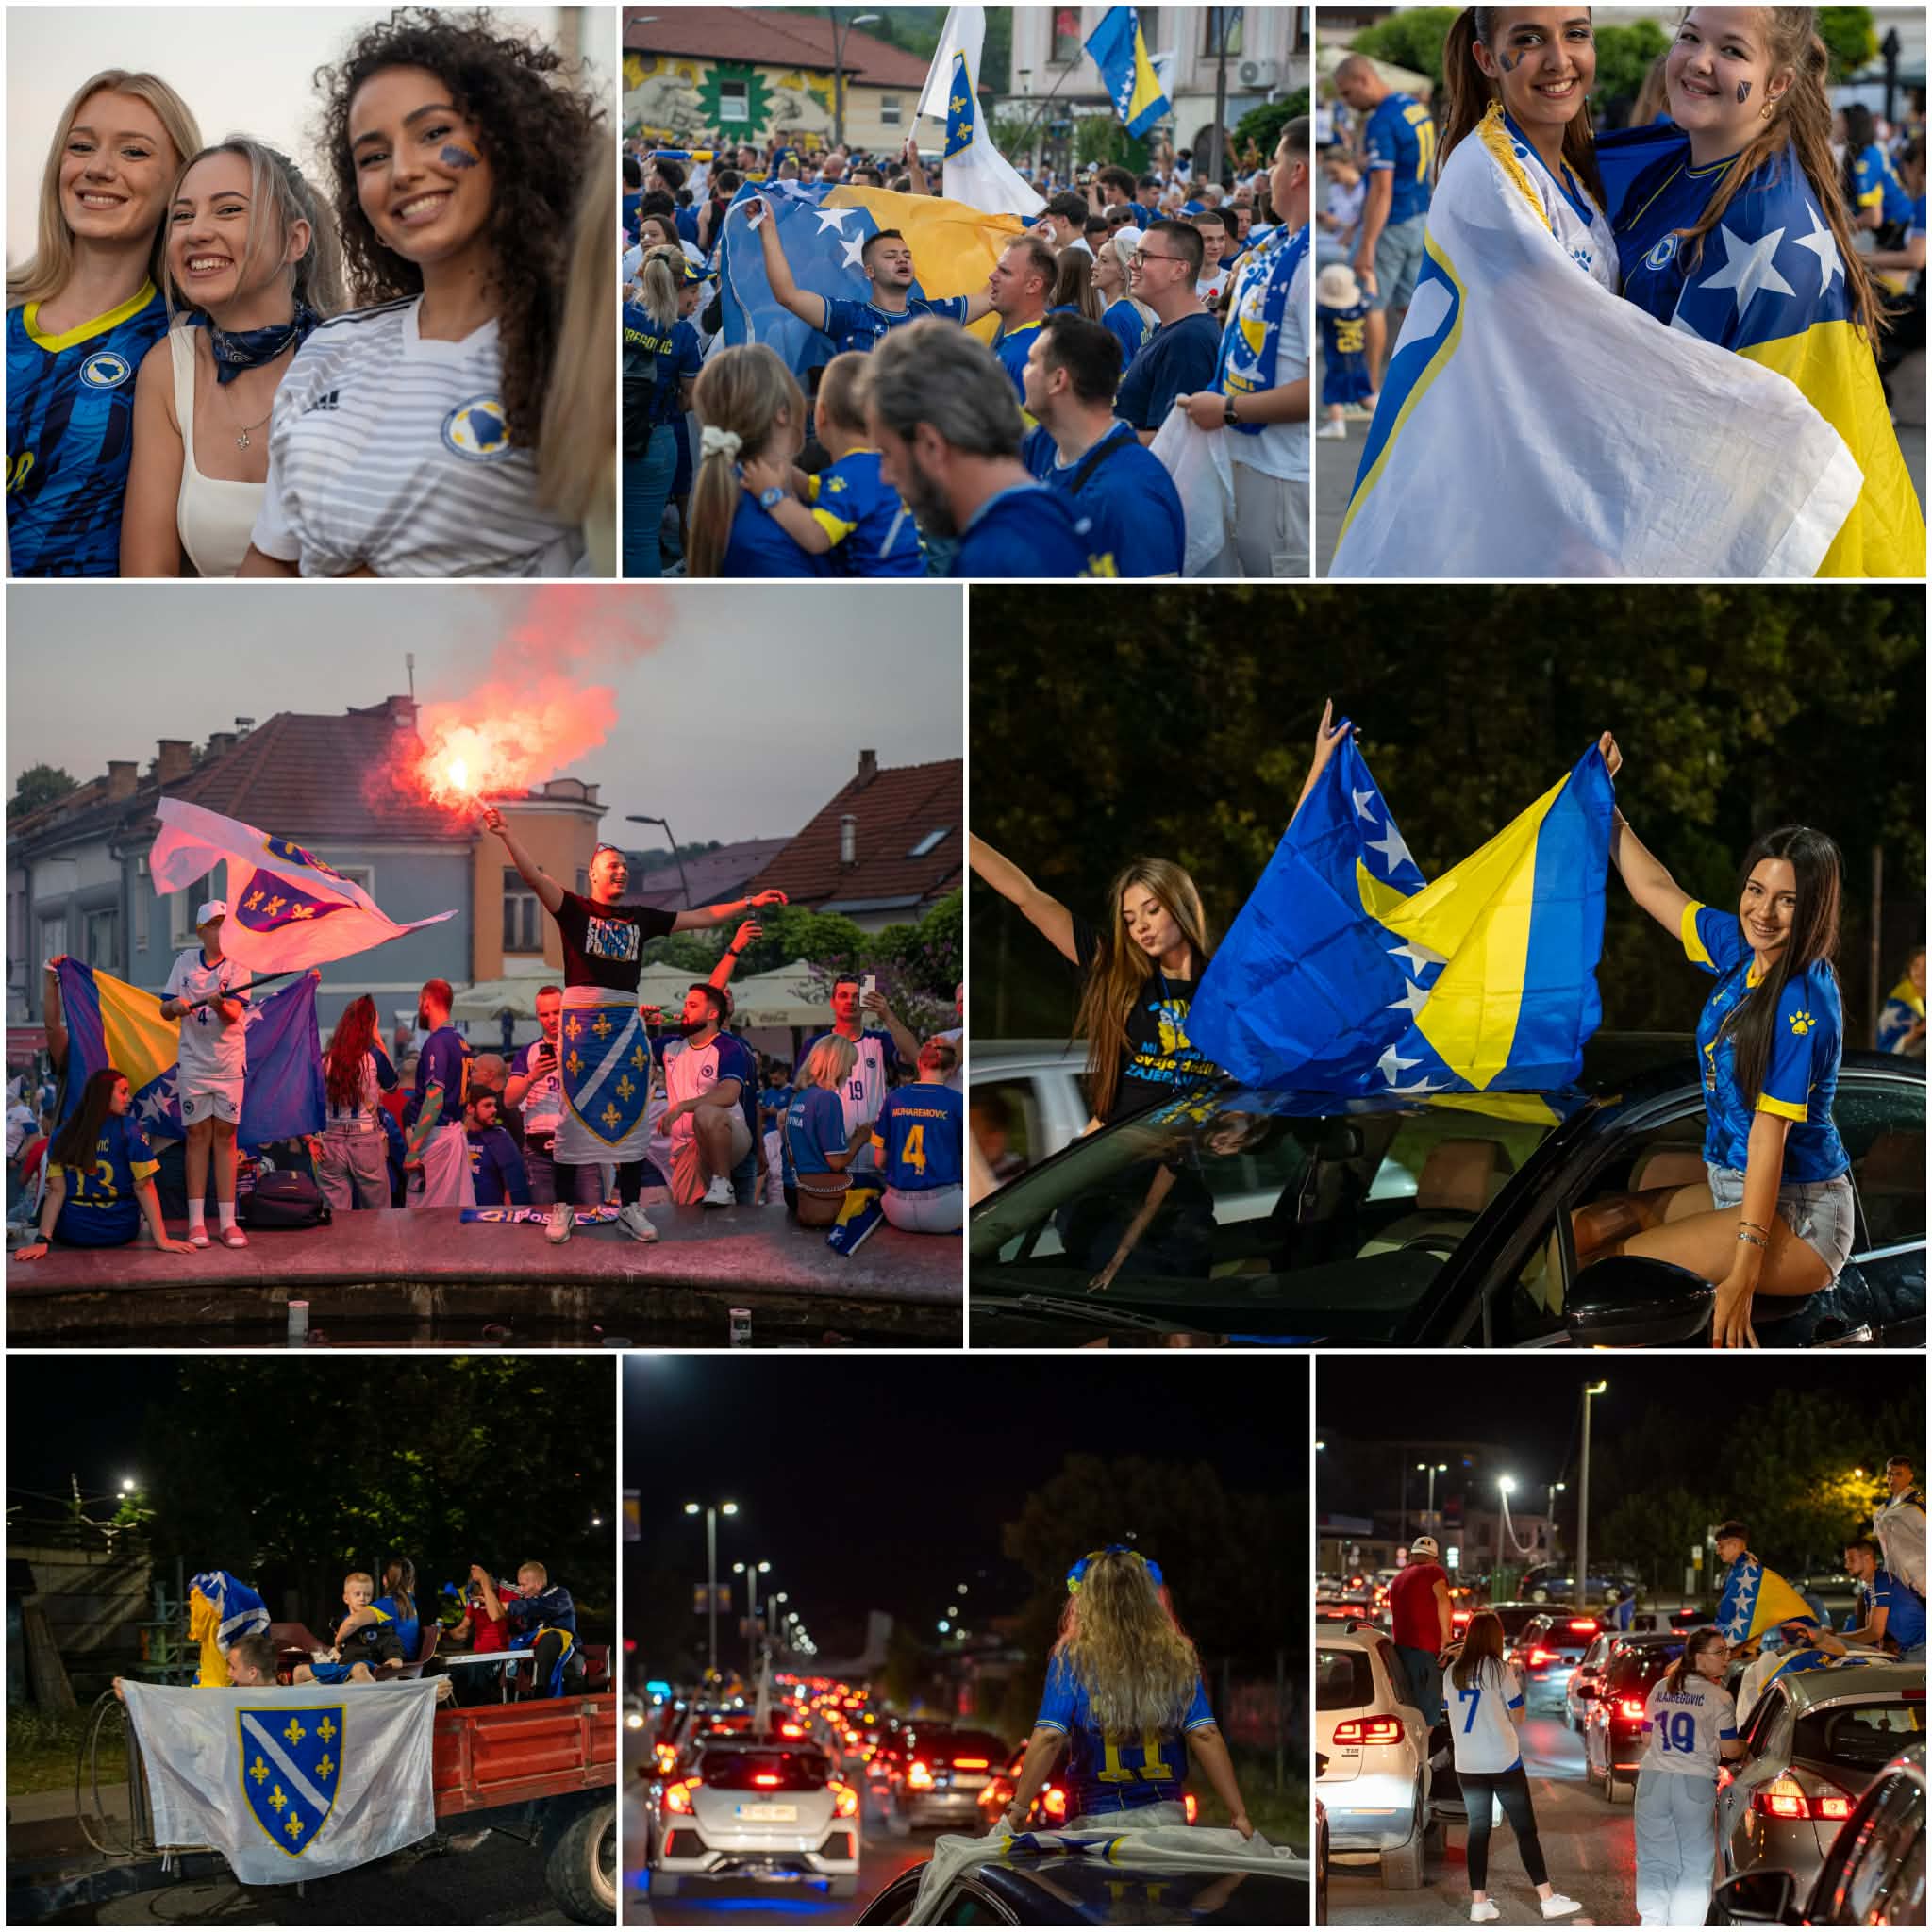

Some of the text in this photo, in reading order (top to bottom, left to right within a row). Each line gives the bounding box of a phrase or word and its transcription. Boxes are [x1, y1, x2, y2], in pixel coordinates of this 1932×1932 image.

[197, 1007, 208, 1025] 4
[849, 1080, 863, 1101] 19
[902, 1124, 926, 1174] 4
[70, 1160, 118, 1208] 13
[1458, 1689, 1481, 1734] 7
[1654, 1711, 1695, 1753] 19
[1098, 1728, 1174, 1781] 11
